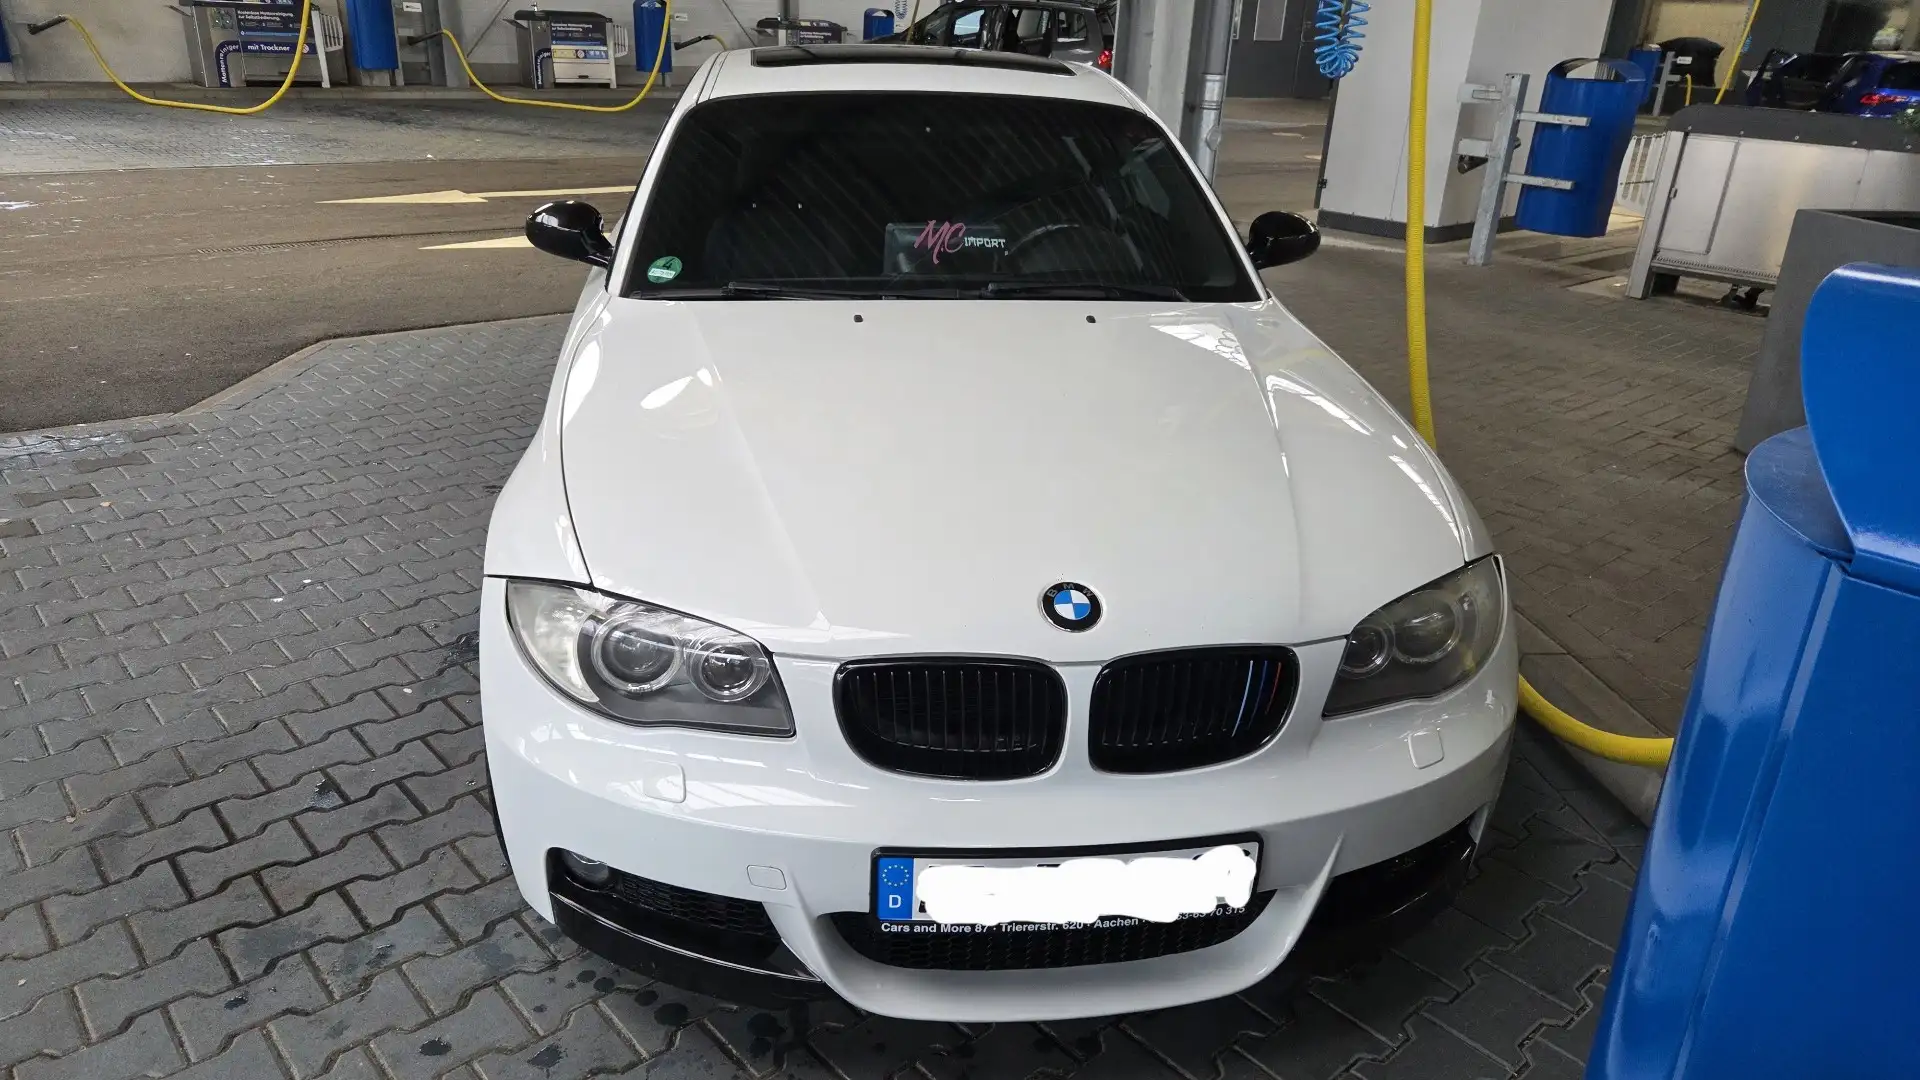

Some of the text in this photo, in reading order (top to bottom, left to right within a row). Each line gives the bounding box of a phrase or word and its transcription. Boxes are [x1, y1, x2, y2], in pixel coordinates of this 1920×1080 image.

[260, 44, 290, 52] Trockner
[964, 236, 1006, 248] IMPORT
[1046, 583, 1095, 598] BMW
[888, 894, 902, 909] D
[881, 922, 910, 933] Cars
[913, 922, 937, 933] and
[940, 923, 971, 933] More
[974, 923, 988, 933] 87
[1000, 921, 1059, 932] Triererstr.
[1062, 921, 1084, 930] 620
[1093, 917, 1139, 929] Aachen
